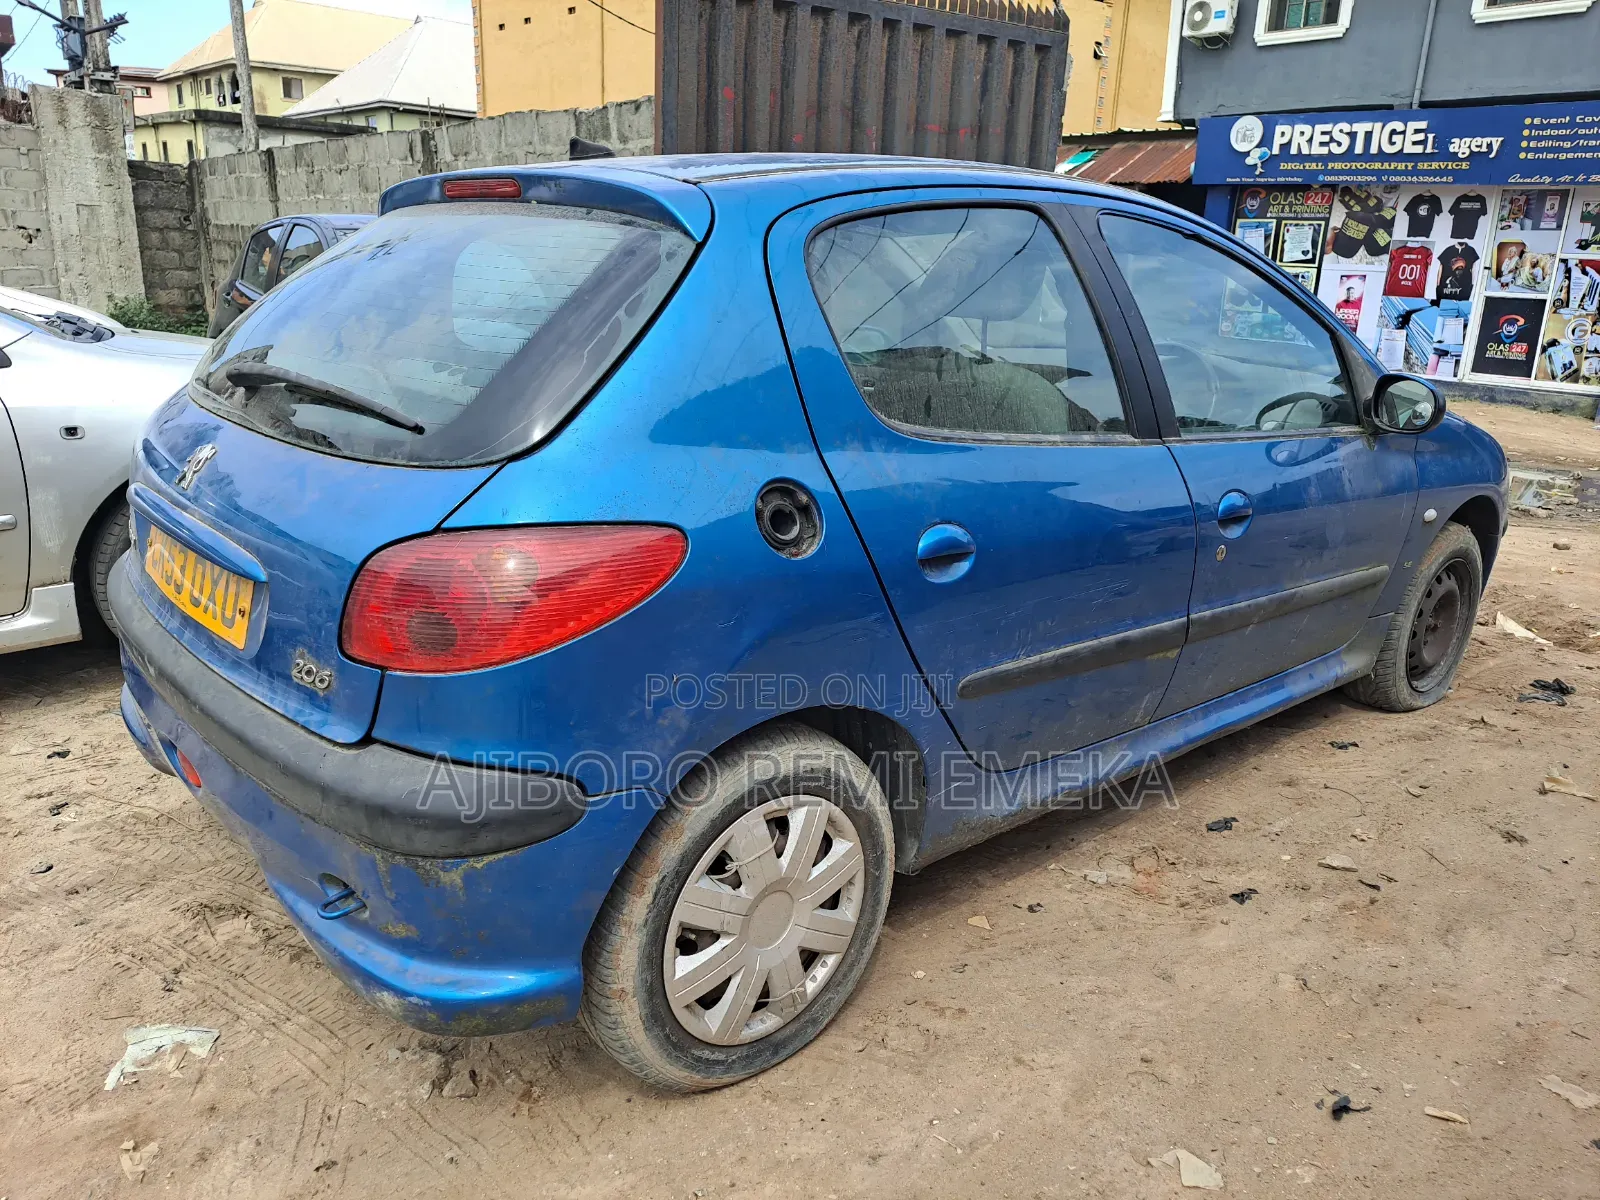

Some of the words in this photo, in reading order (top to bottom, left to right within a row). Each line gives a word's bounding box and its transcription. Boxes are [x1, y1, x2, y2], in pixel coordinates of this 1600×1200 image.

[1533, 116, 1570, 124] Event
[1531, 127, 1600, 136] Indoor/out
[1271, 120, 1428, 155] PRESTIGE
[1327, 162, 1414, 170] PHOTOGRAPHY
[1417, 161, 1470, 170] SERVICE
[1508, 173, 1553, 184] Quality
[1270, 191, 1303, 205] OLAS
[1307, 192, 1330, 205] 247
[1267, 204, 1282, 213] ART
[1283, 204, 1290, 213] &
[1291, 204, 1330, 213] PRINTING
[1398, 263, 1421, 280] 001
[1487, 342, 1510, 352] OLAS
[1511, 344, 1527, 352] 247
[291, 659, 332, 689] 206
